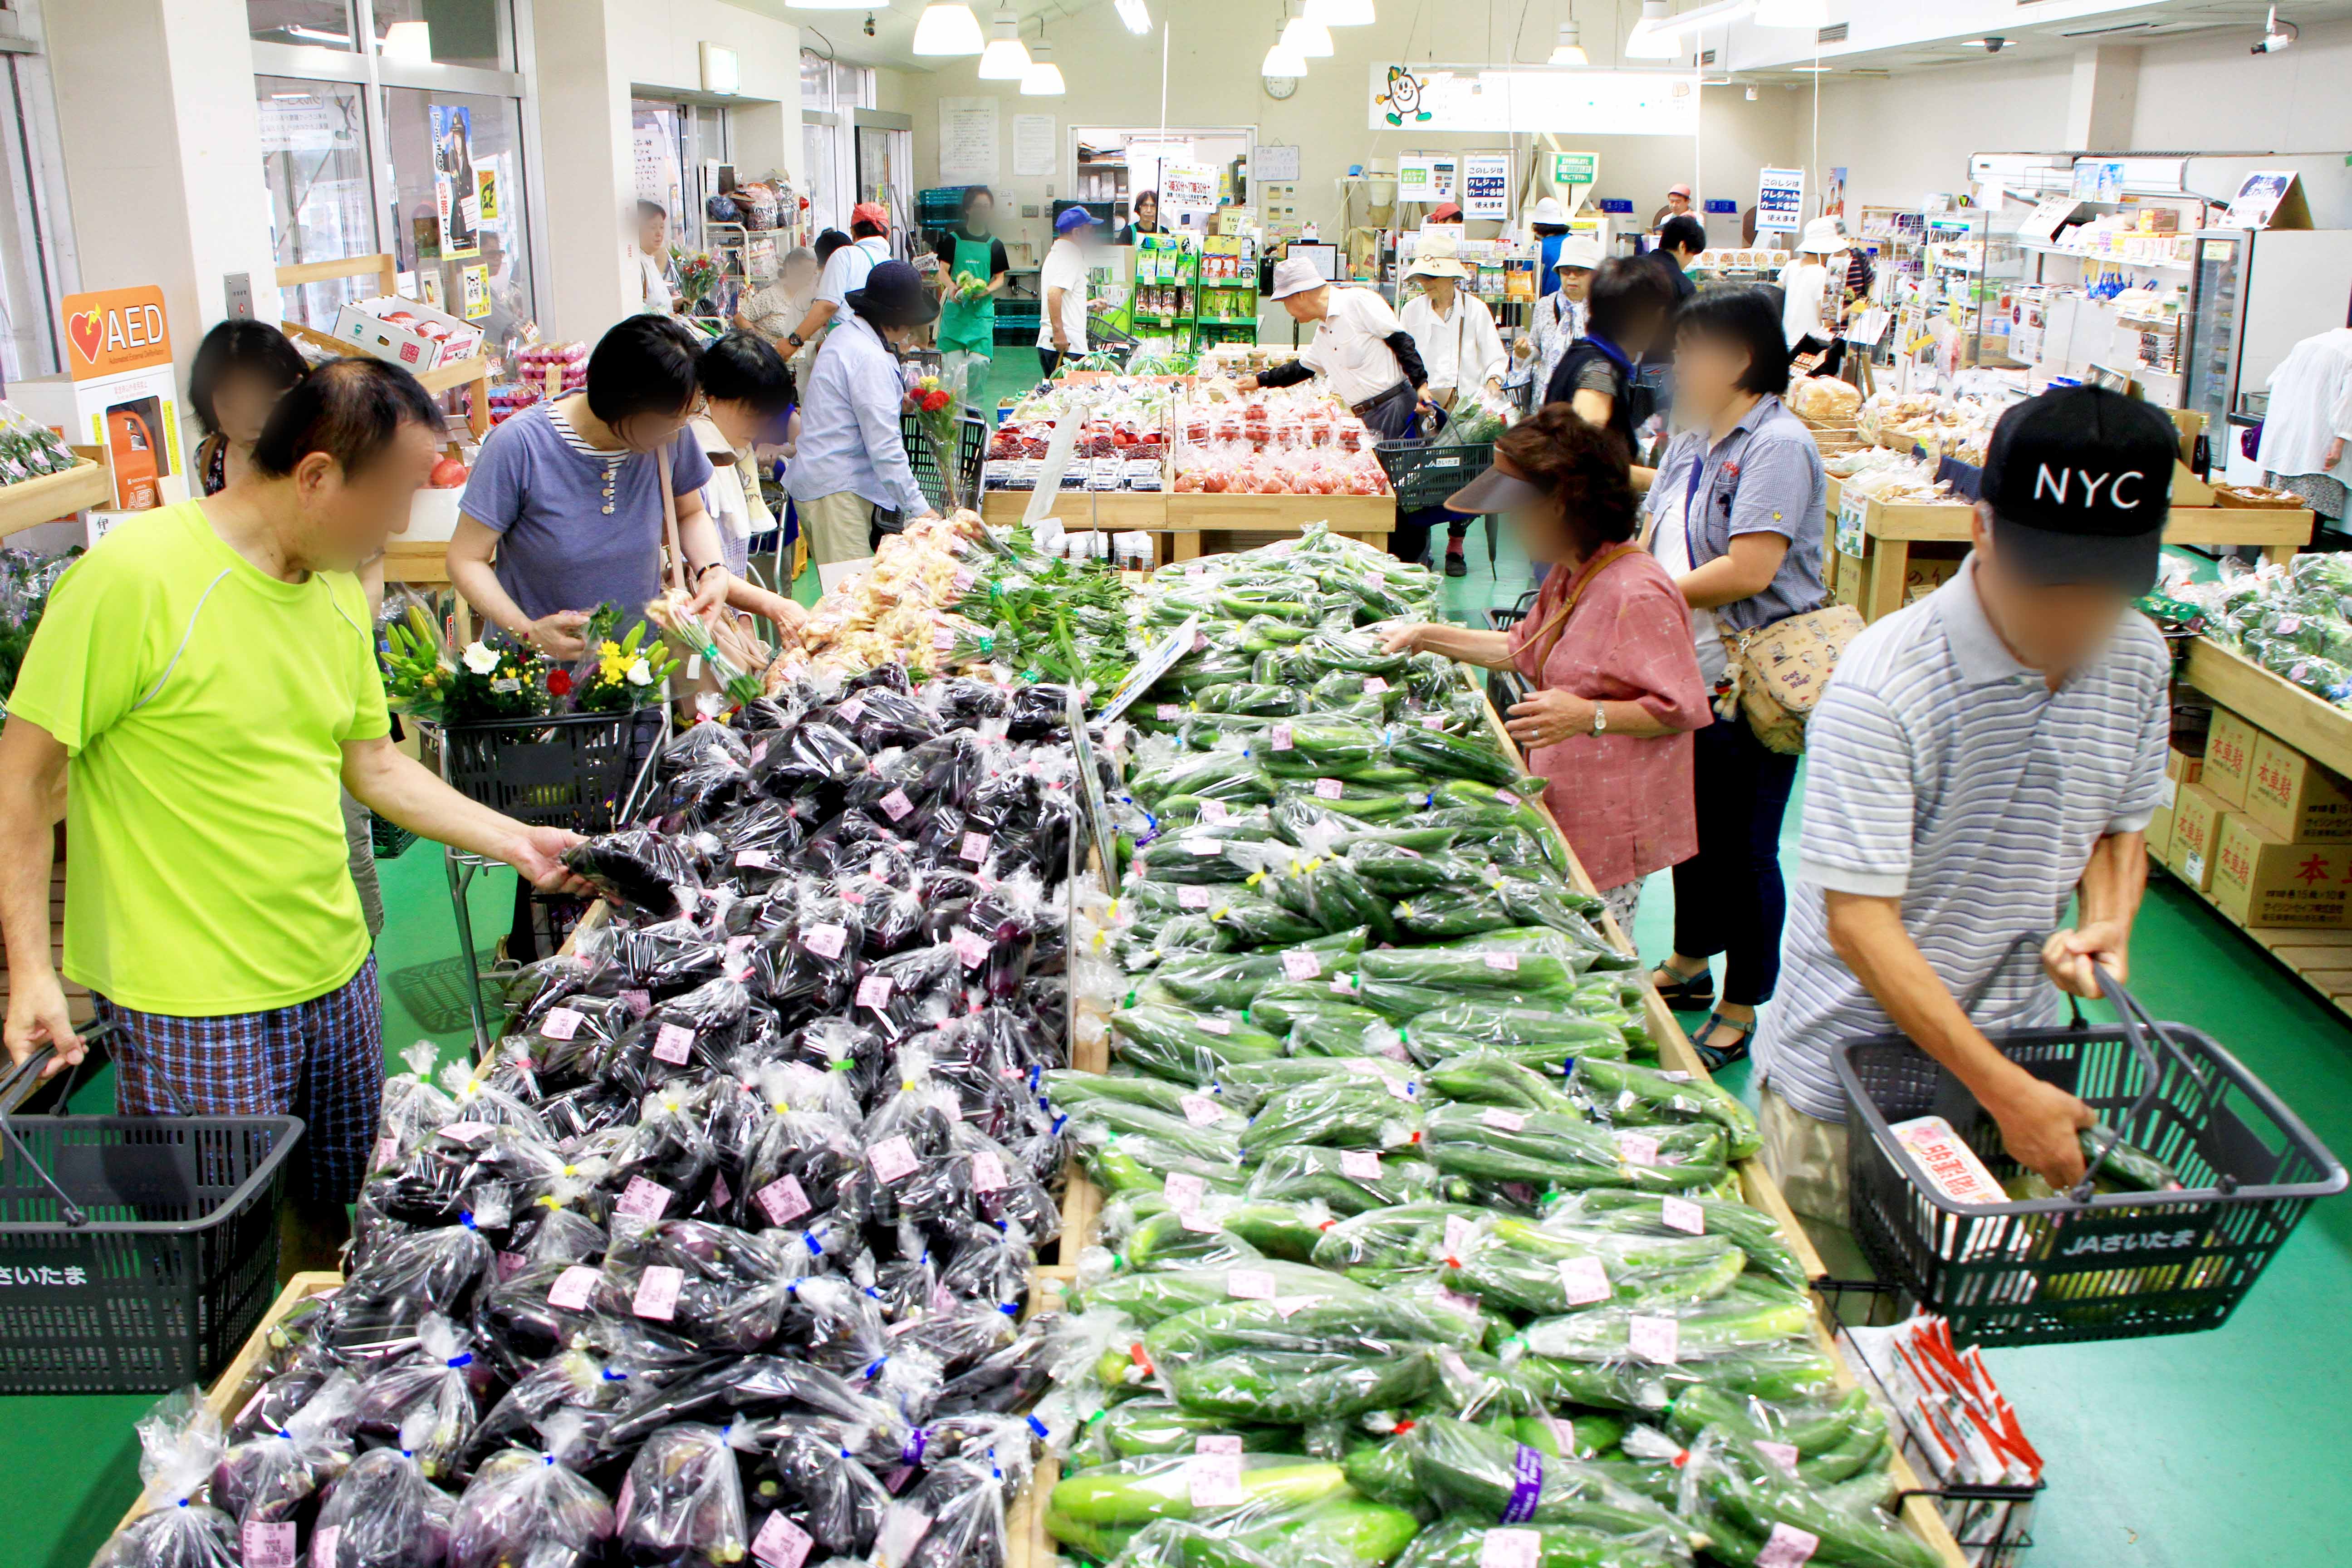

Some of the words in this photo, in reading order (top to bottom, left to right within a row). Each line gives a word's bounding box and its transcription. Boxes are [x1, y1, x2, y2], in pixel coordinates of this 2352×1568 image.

[1468, 178, 1504, 187] クレジット
[1763, 179, 1799, 188] このレジは
[1468, 188, 1504, 197] カード各種
[1762, 190, 1799, 200] クレジット
[1760, 201, 1799, 211] カード各種
[1768, 214, 1796, 222] 使えます
[107, 304, 164, 352] AED
[2033, 462, 2145, 510] NYC
[127, 488, 154, 509] AED
[2063, 1229, 2195, 1256] JAさいたま
[0, 1265, 88, 1285] さいたま
